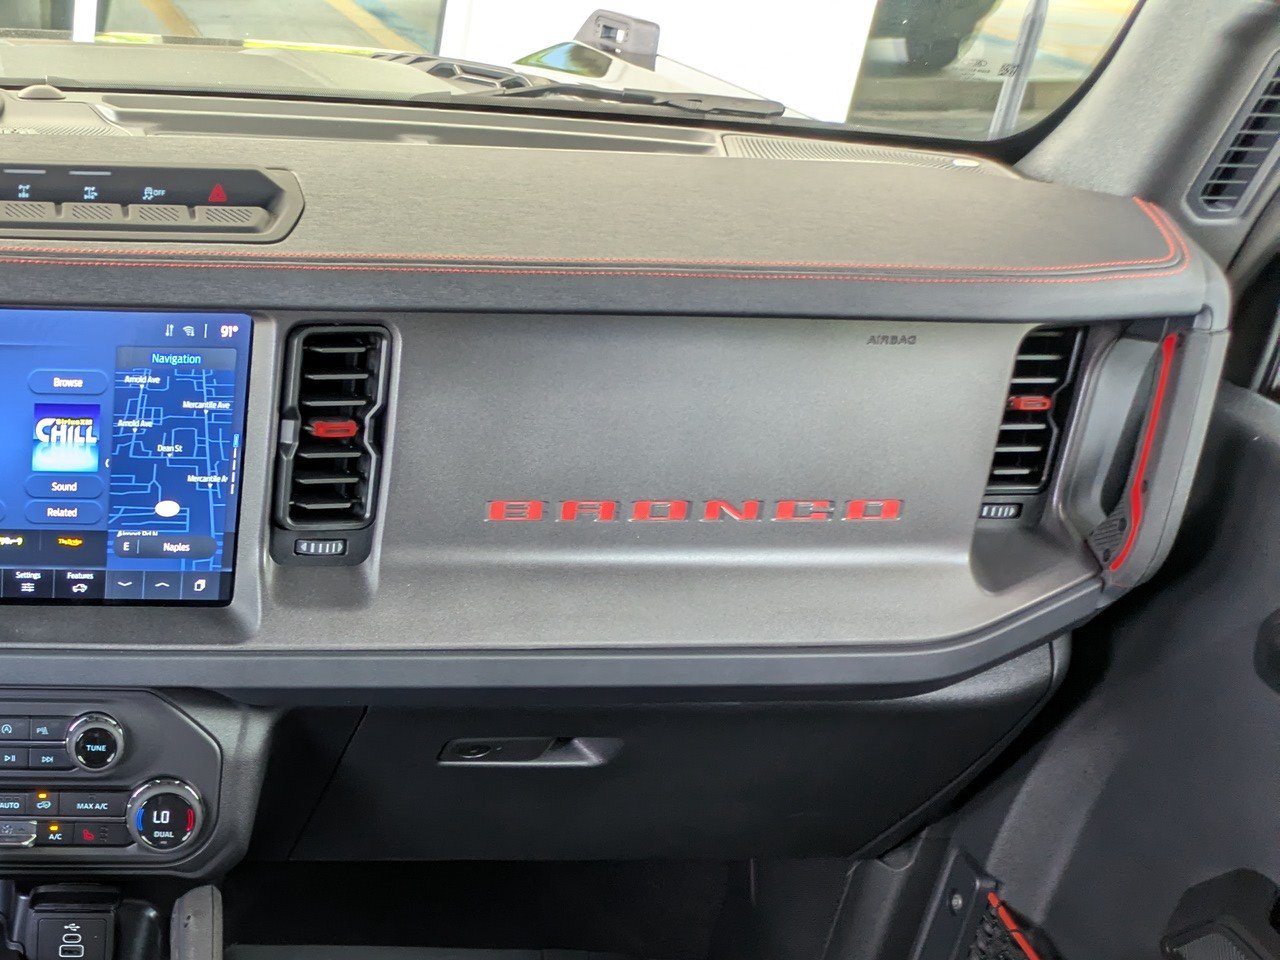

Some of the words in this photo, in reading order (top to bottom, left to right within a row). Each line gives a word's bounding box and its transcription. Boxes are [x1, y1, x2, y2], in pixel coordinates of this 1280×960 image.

[866, 335, 917, 346] AIRBAG
[151, 353, 201, 366] Navigation
[53, 377, 83, 388] Browse
[124, 375, 147, 384] Arnold
[148, 376, 161, 384] Ave
[182, 401, 216, 409] Mercantile
[217, 401, 231, 409] Ave
[117, 419, 140, 428] Arnold
[140, 420, 154, 428] Ave
[157, 444, 174, 453] Dean
[175, 444, 183, 452] St
[51, 481, 78, 492] Sound
[47, 507, 78, 518] Related
[484, 499, 907, 522] BRONCO
[123, 542, 130, 551] E
[163, 542, 190, 553] Naples
[15, 571, 41, 580] Settings
[67, 571, 94, 581] Features
[85, 744, 107, 752] TUNE
[76, 802, 94, 810] MAX
[95, 802, 109, 810] A/C
[153, 810, 170, 824] LO
